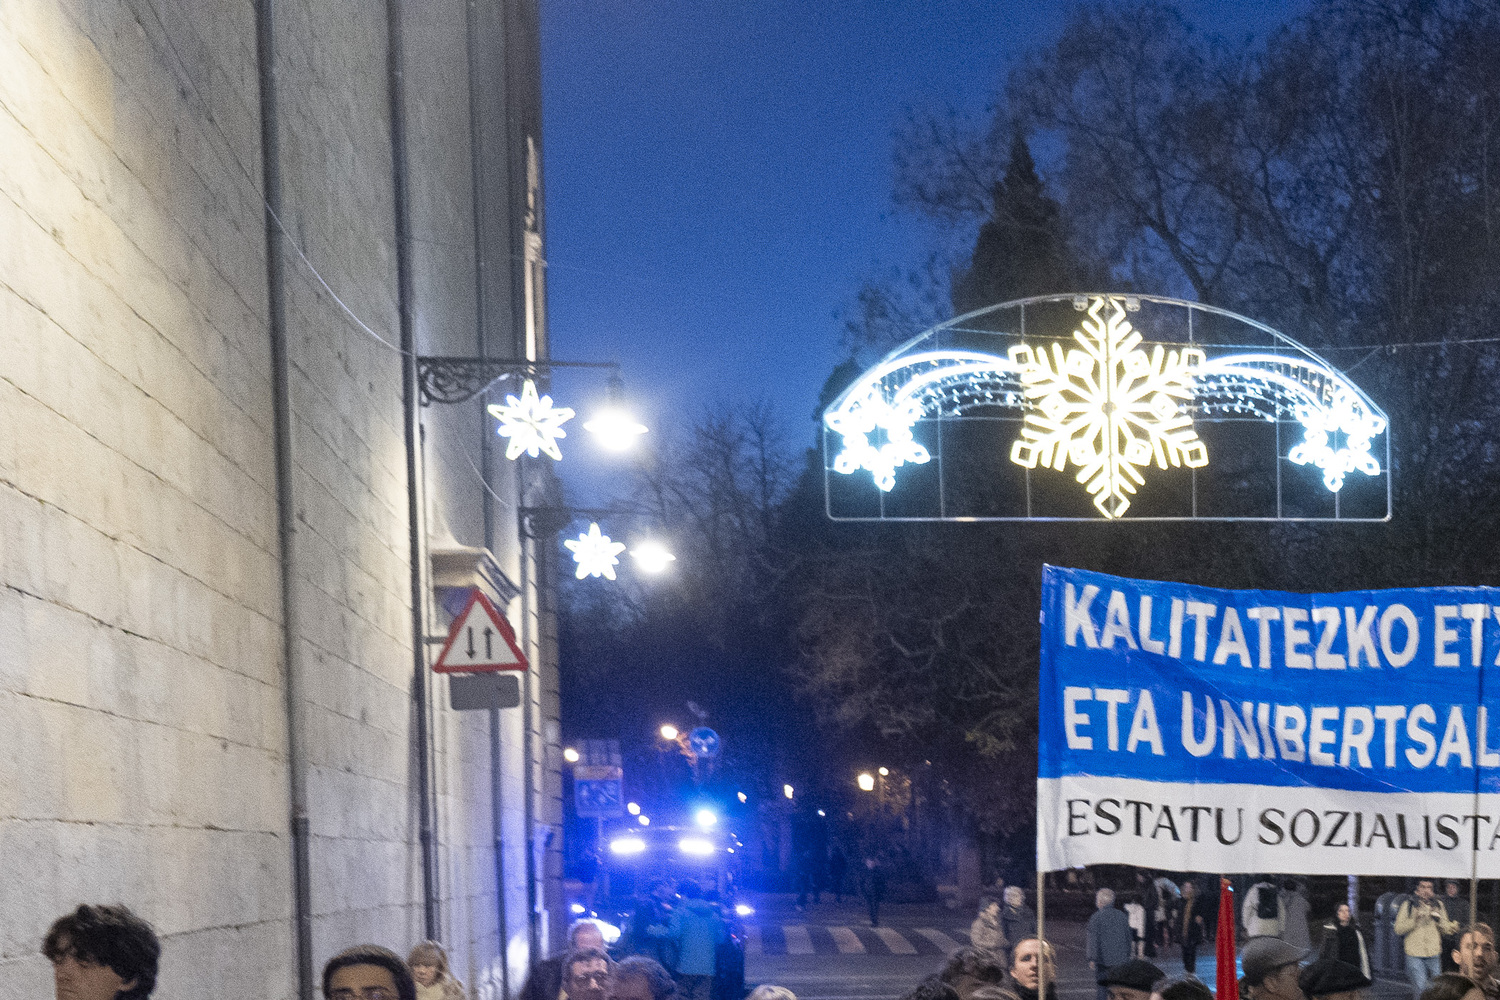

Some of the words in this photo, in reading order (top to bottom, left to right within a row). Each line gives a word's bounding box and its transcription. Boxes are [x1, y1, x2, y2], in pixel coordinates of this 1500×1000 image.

[1064, 582, 1420, 670] KALITATEZKO
[1063, 686, 1166, 756] ETA
[1066, 798, 1244, 846] ESTATU
